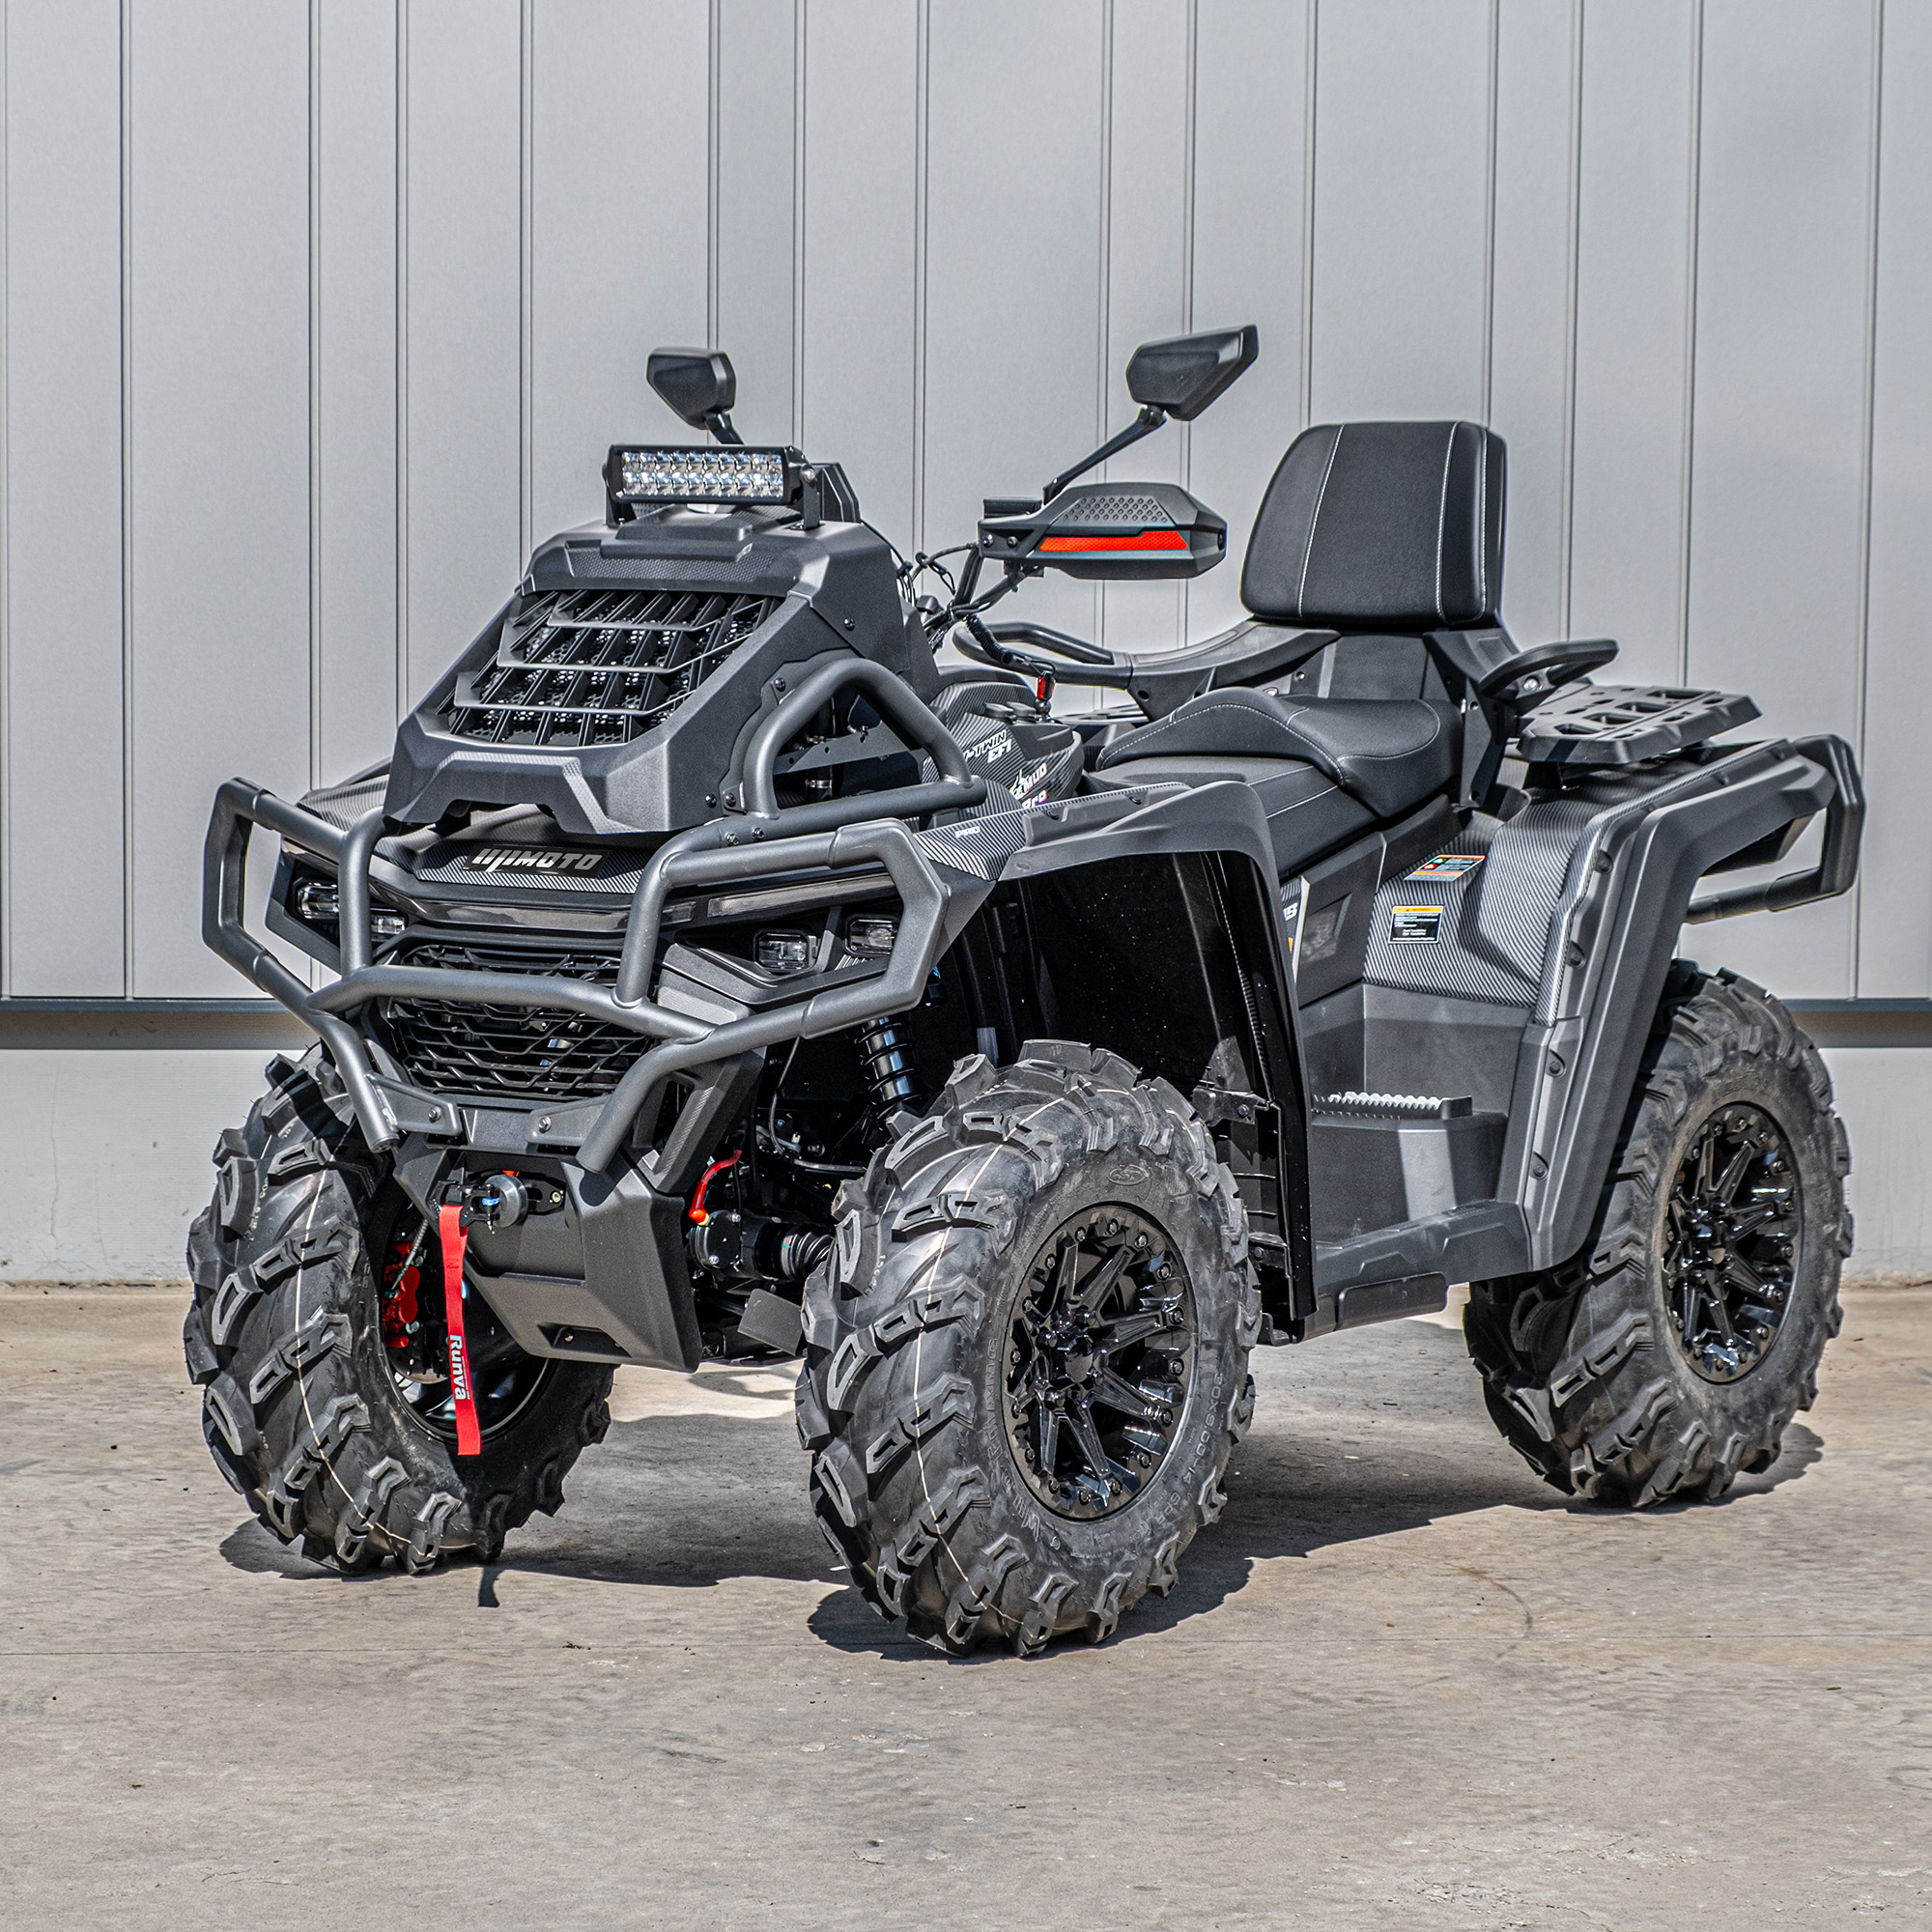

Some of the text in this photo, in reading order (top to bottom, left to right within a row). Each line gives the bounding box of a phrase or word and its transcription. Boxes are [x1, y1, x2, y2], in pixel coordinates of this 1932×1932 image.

[987, 738, 1012, 763] EFI
[1023, 762, 1048, 793] MUD
[449, 1334, 467, 1400] Runva
